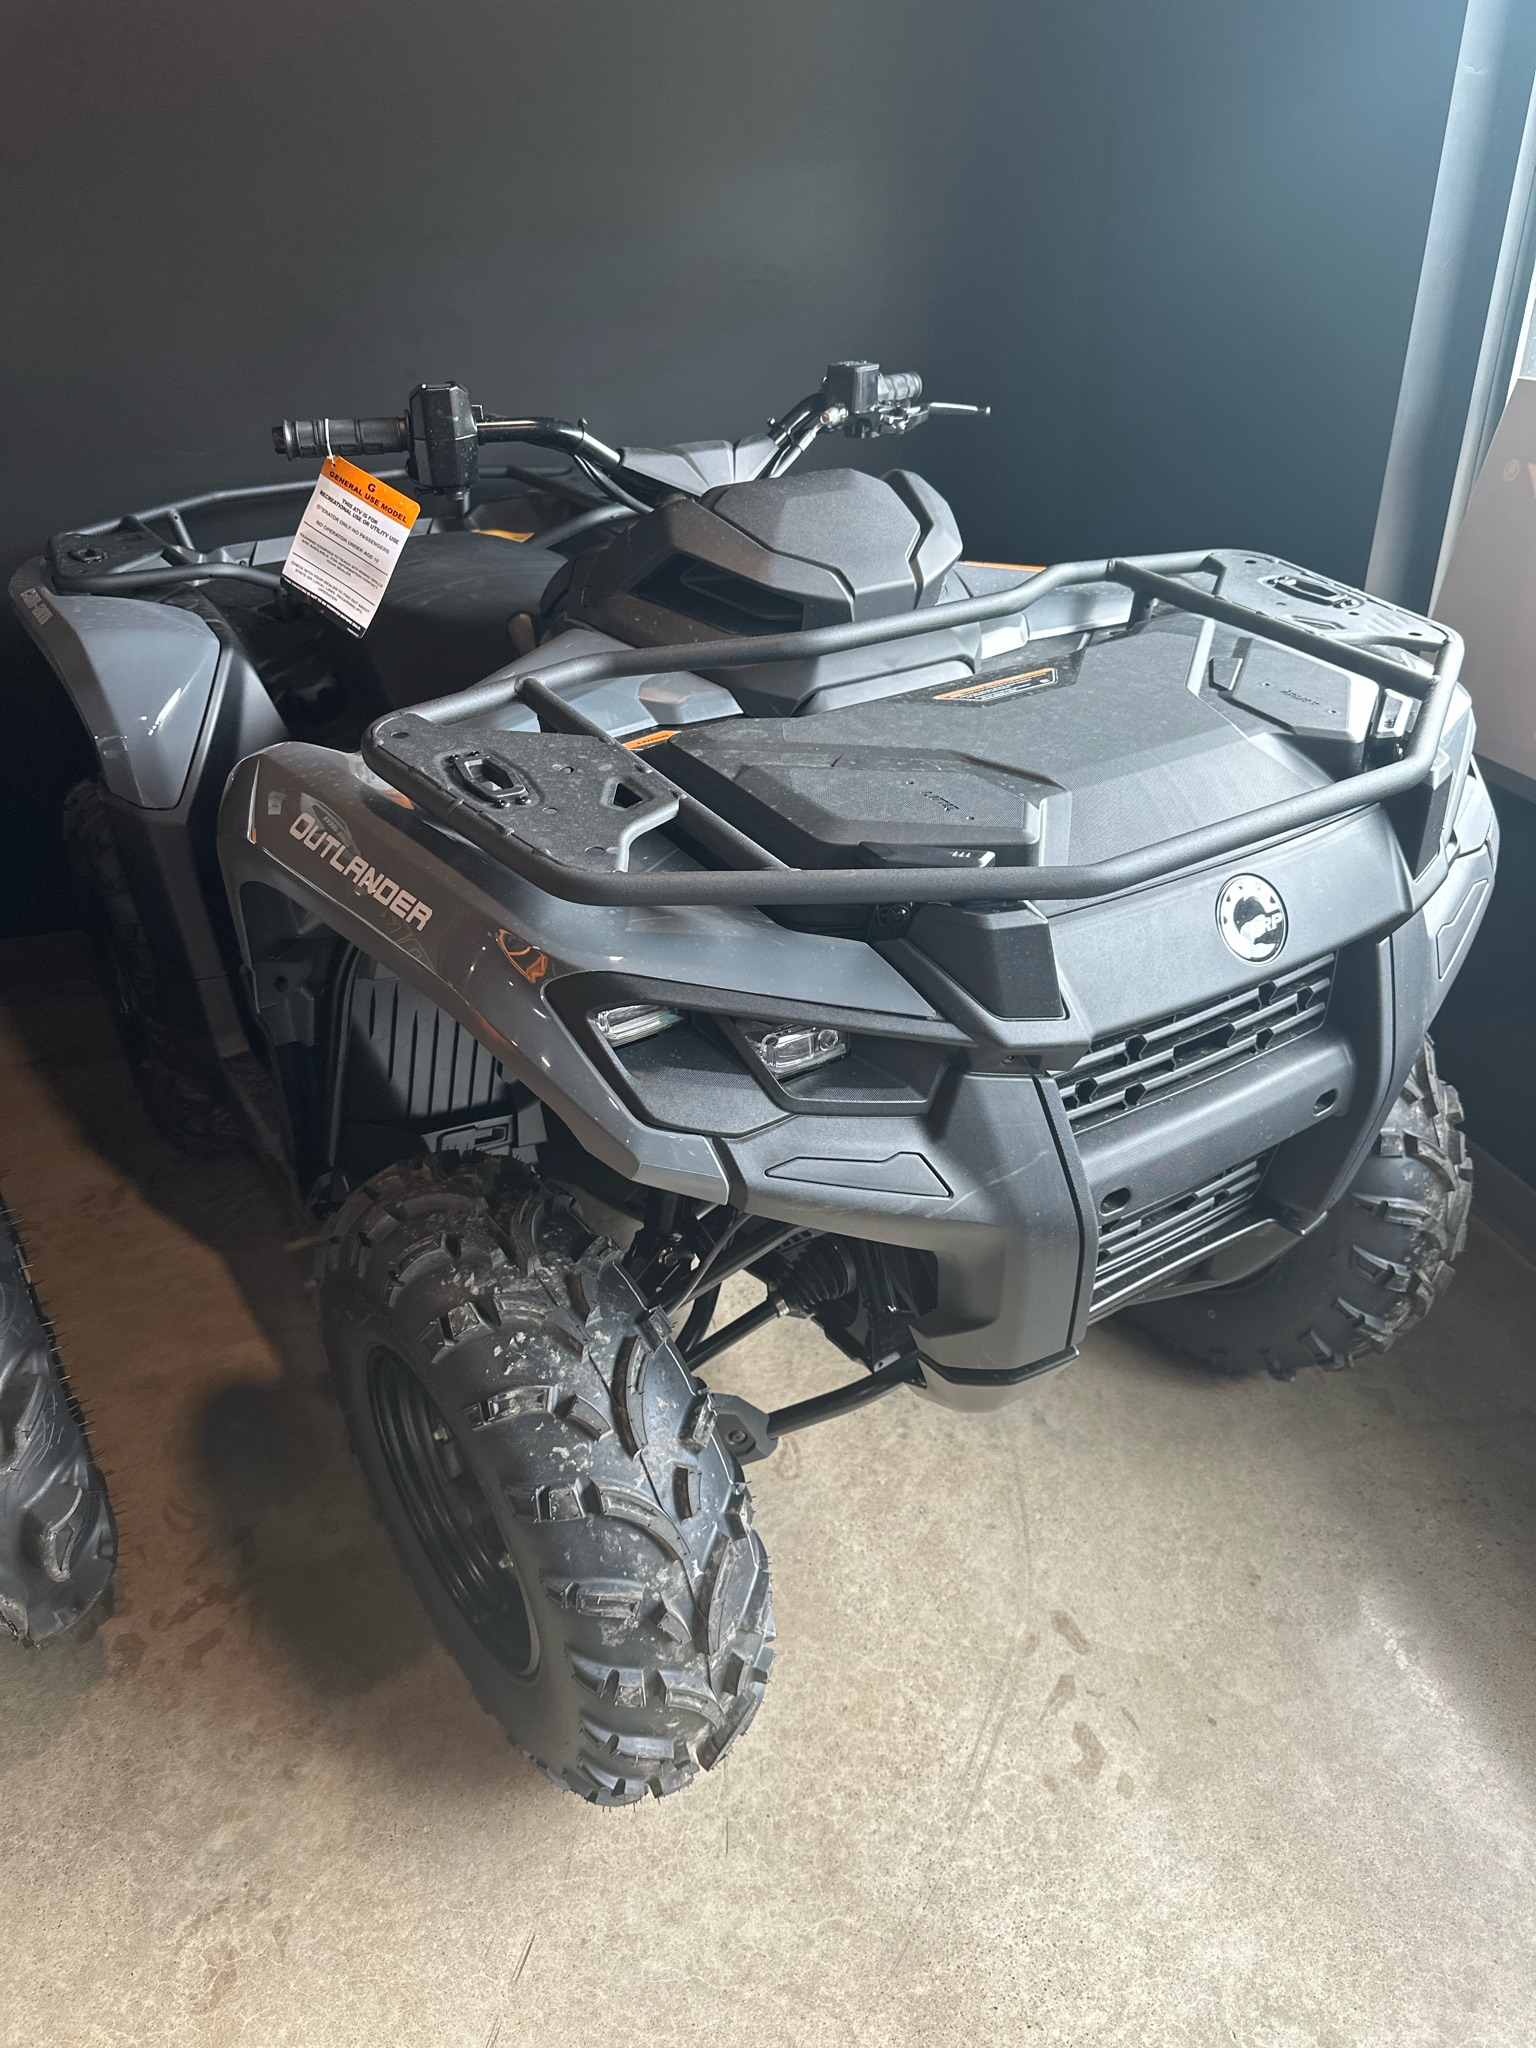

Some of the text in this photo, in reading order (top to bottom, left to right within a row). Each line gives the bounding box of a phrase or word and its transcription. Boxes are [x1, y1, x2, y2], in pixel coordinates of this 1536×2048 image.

[328, 470, 408, 524] GENERAL USE MODEL
[366, 481, 377, 493] G
[318, 489, 399, 545] RECREATIONAL USE OR UTILITY USE
[341, 498, 353, 509] THIS
[352, 505, 362, 515] ATV
[367, 514, 378, 525] FOR
[315, 519, 323, 528] NO
[322, 524, 347, 543] OPERATOR
[346, 540, 363, 553] UNDER
[362, 550, 373, 560] AGE
[358, 531, 390, 554] PASSENGERS
[289, 812, 433, 932] OUTLANDER
